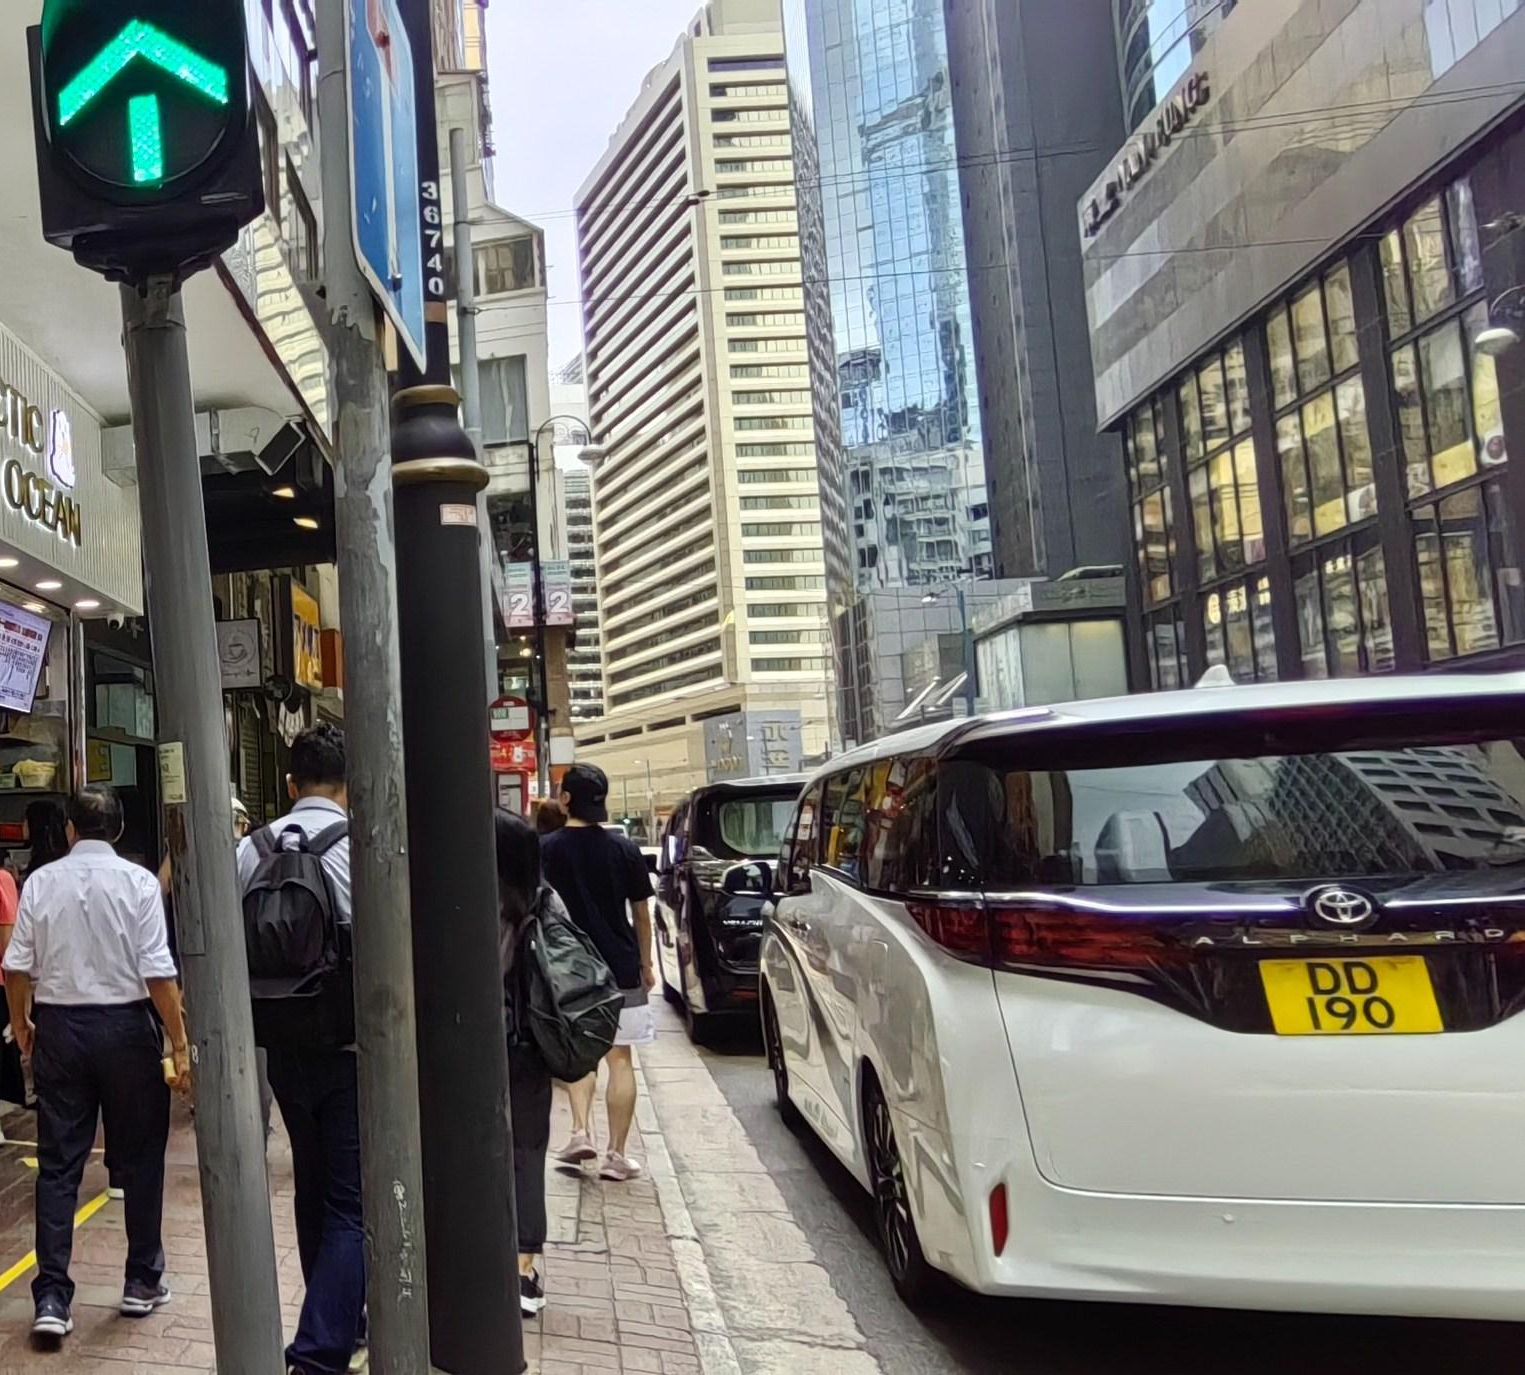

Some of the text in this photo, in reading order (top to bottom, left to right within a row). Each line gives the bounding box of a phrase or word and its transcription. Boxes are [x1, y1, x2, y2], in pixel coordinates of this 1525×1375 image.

[421, 180, 445, 297] 36740
[2, 458, 82, 547] OCEAN
[510, 593, 529, 616] 2
[549, 591, 569, 613] 2
[1194, 929, 1506, 945] ALPHARD
[1305, 962, 1380, 996] DD
[1305, 996, 1396, 1031] 190
